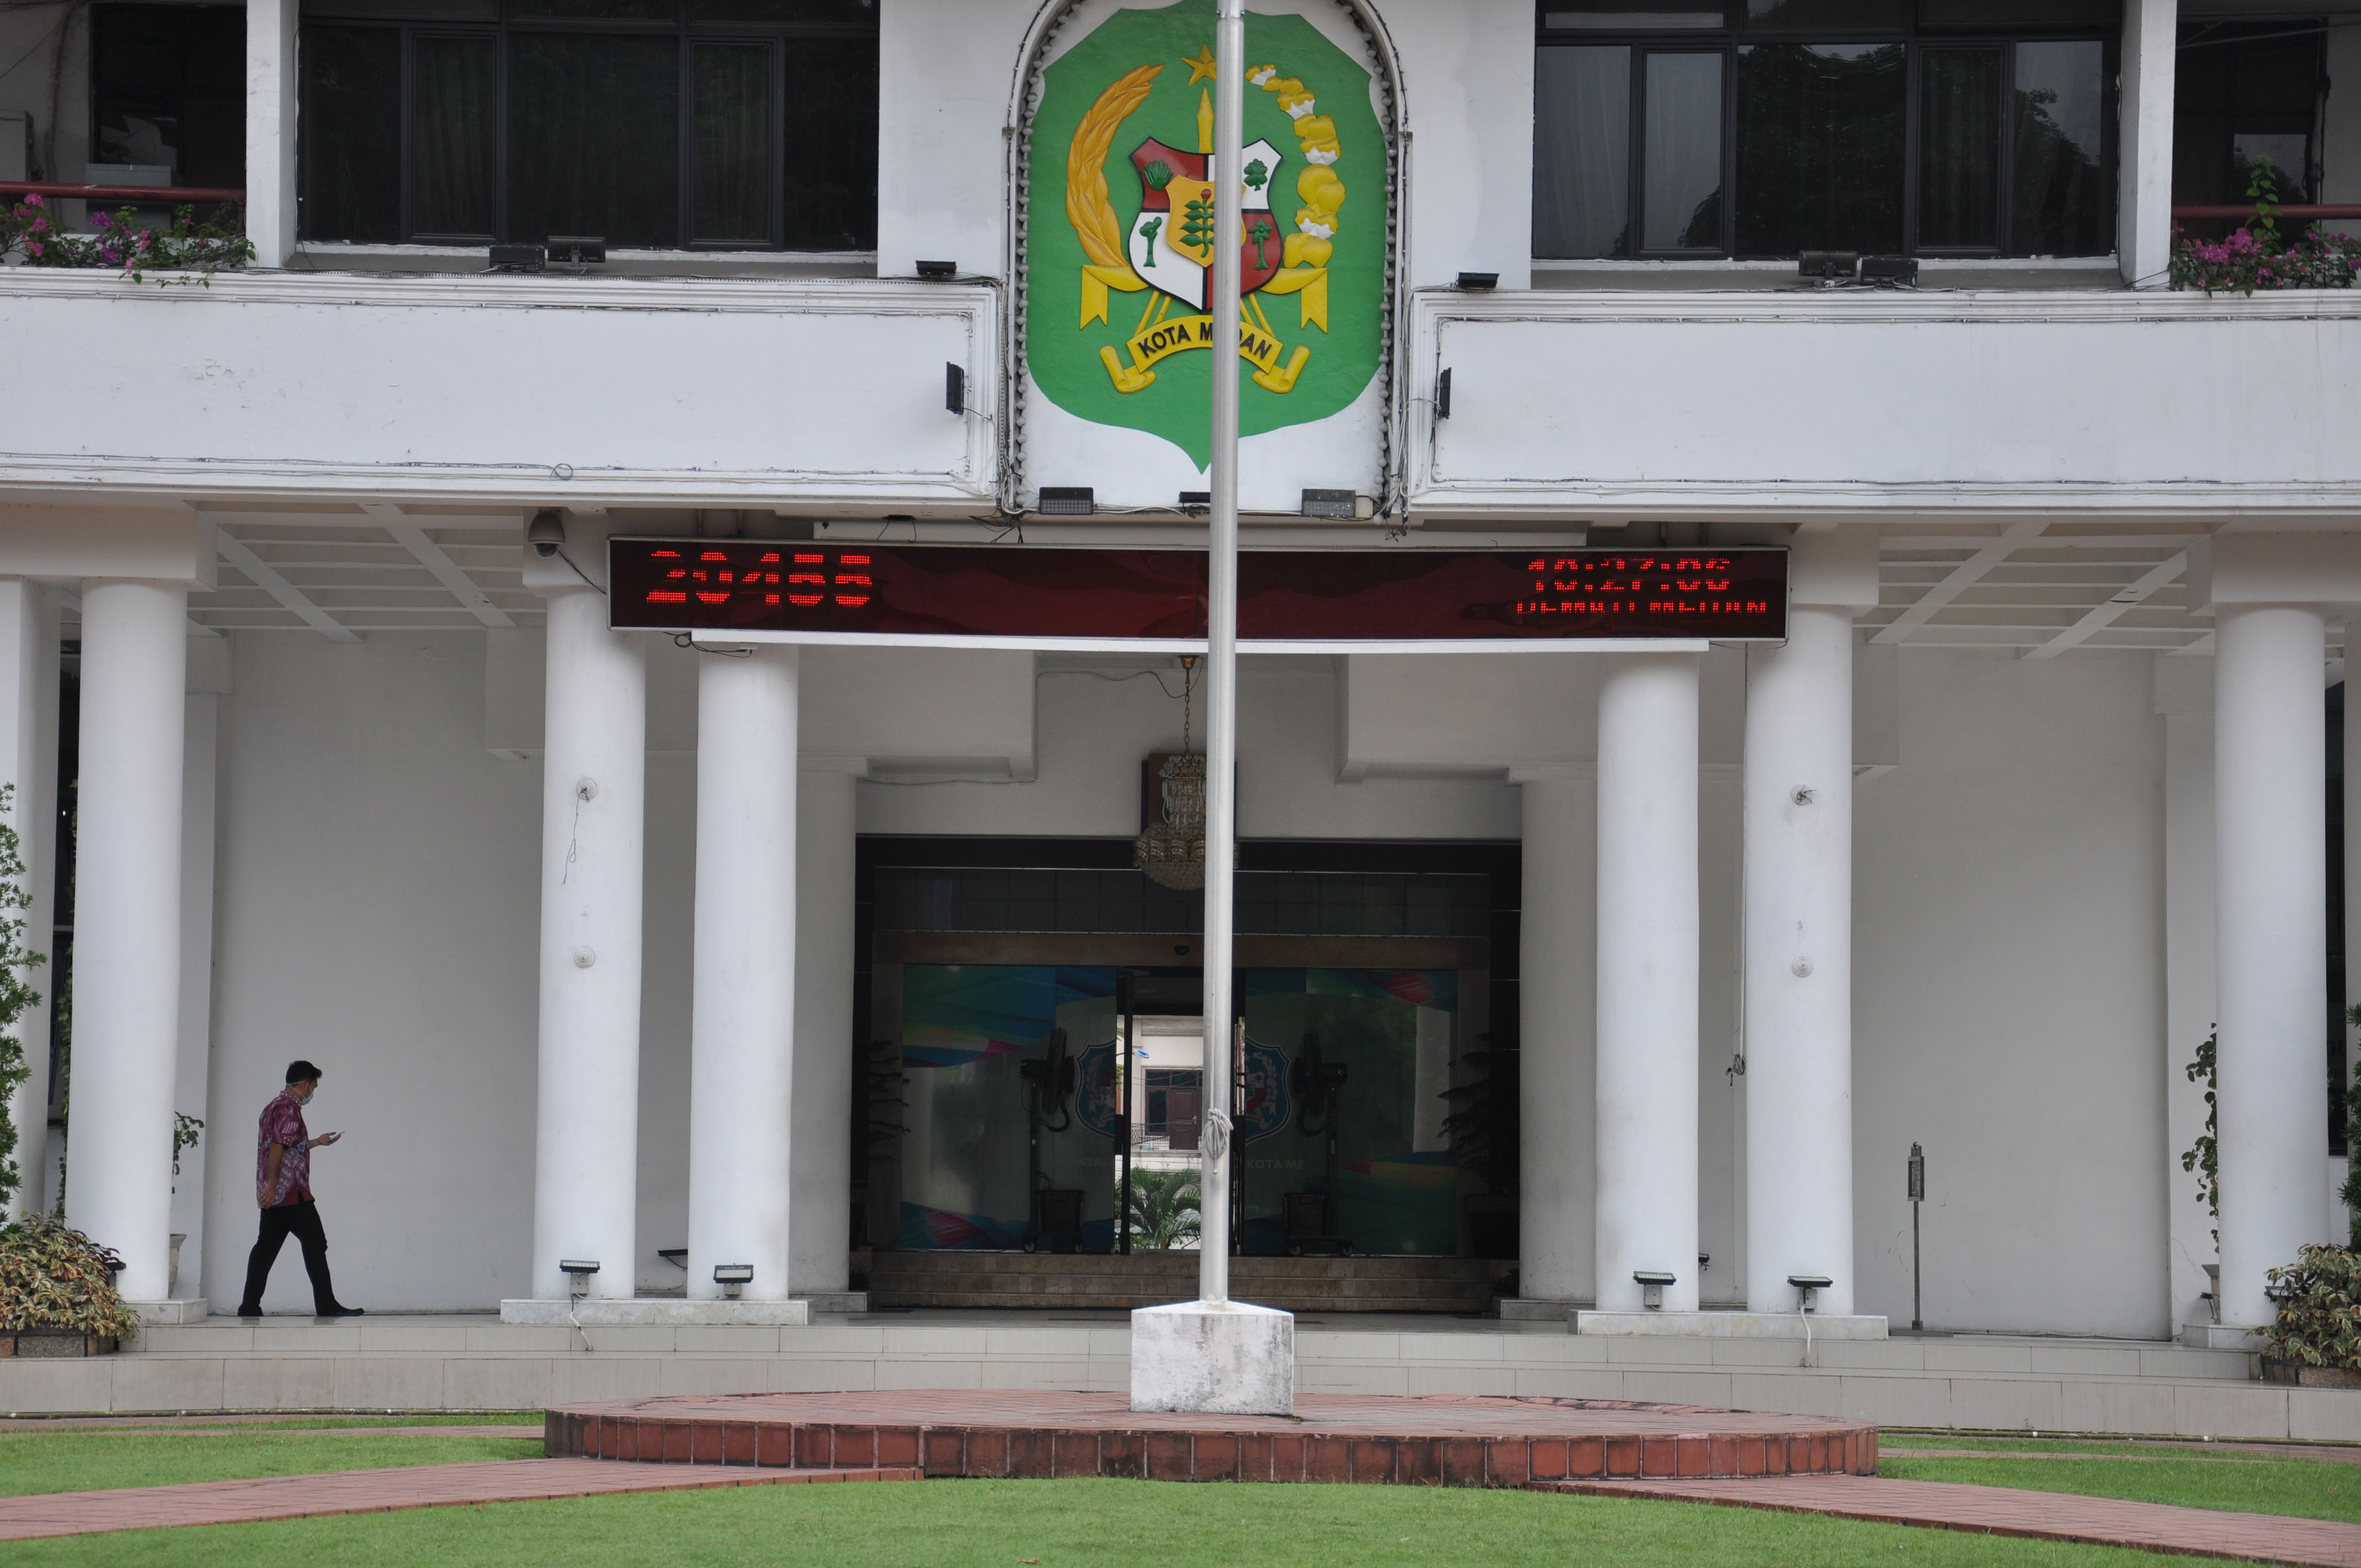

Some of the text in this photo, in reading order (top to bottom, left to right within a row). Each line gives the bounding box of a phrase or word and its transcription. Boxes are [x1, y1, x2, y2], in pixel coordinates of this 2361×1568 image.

[1138, 322, 1272, 360] KOTA MAN
[1247, 1159, 1282, 1169] KOTA
